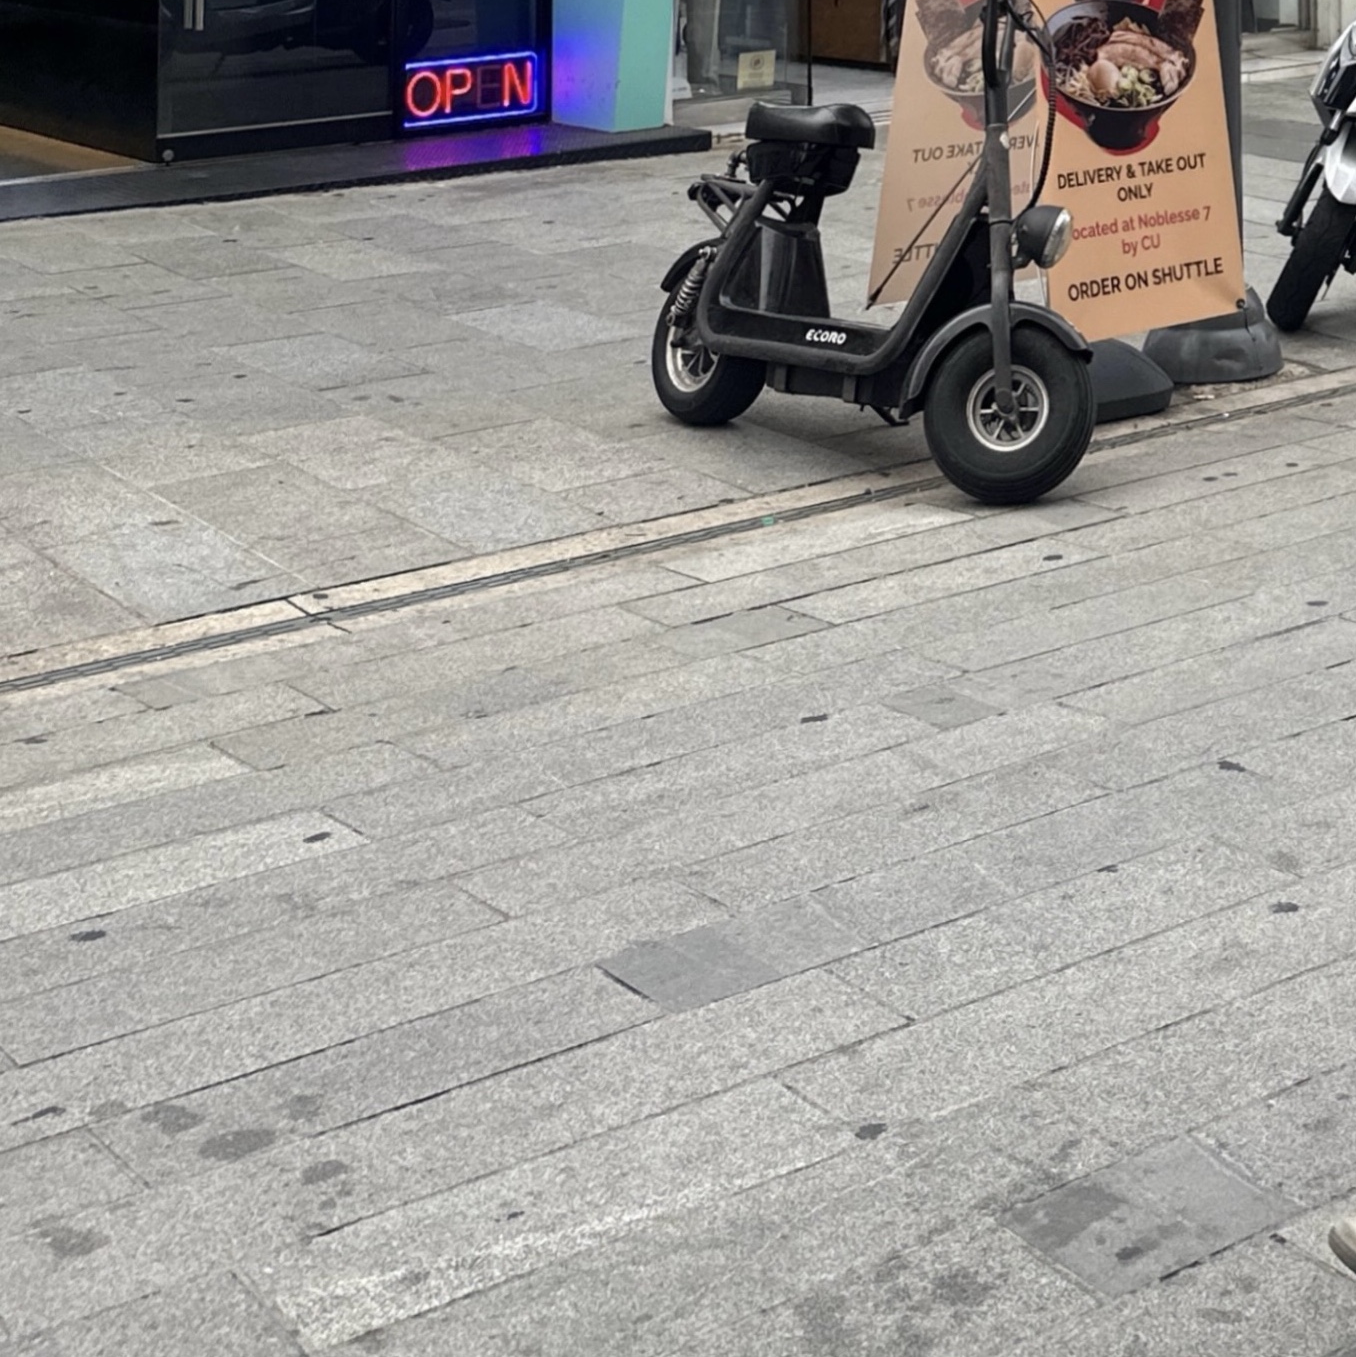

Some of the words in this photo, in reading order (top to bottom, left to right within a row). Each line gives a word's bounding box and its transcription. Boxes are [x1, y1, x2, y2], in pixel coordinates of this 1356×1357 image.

[407, 61, 532, 117] OPEN
[1057, 164, 1123, 189] DELIVERY
[1126, 163, 1136, 179] &
[1138, 157, 1174, 177] TAKE
[1177, 153, 1206, 171] OUT
[1117, 183, 1154, 202] ONLY
[1072, 219, 1118, 240] ocated
[1122, 216, 1135, 233] at
[1138, 207, 1200, 228] Noblesse
[1203, 206, 1211, 221] 7
[1122, 239, 1139, 258] by
[1141, 234, 1161, 250] CU
[1068, 276, 1122, 302] ORDER
[1124, 272, 1149, 291] ON
[1152, 257, 1224, 285] SHUTTLE
[805, 328, 847, 345] ECORO
